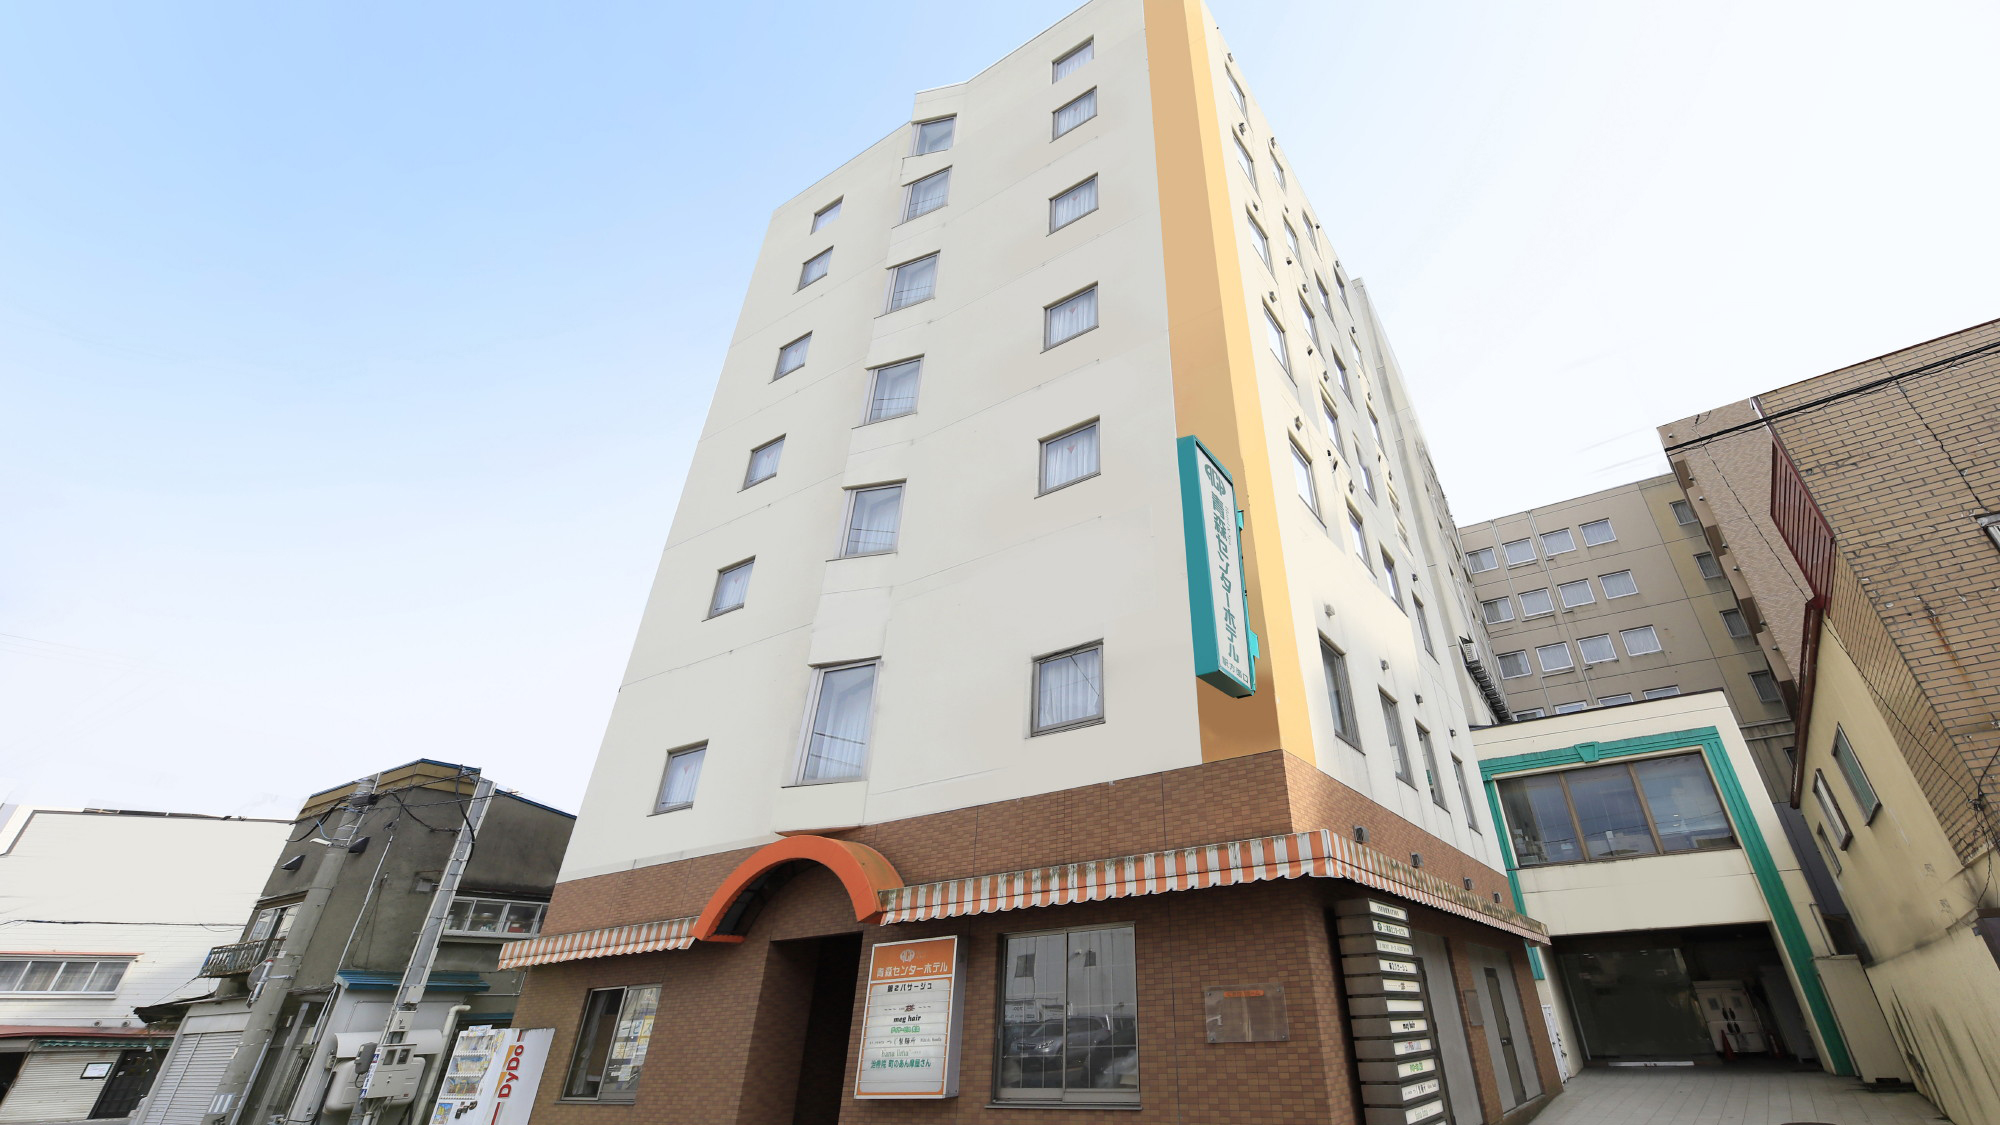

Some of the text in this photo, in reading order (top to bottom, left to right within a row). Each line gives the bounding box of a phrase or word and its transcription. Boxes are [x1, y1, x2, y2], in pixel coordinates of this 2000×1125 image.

[1211, 491, 1239, 664] 青森センターホテル
[877, 962, 948, 978] 青森センターホテル
[498, 1044, 524, 1098] DyDo
